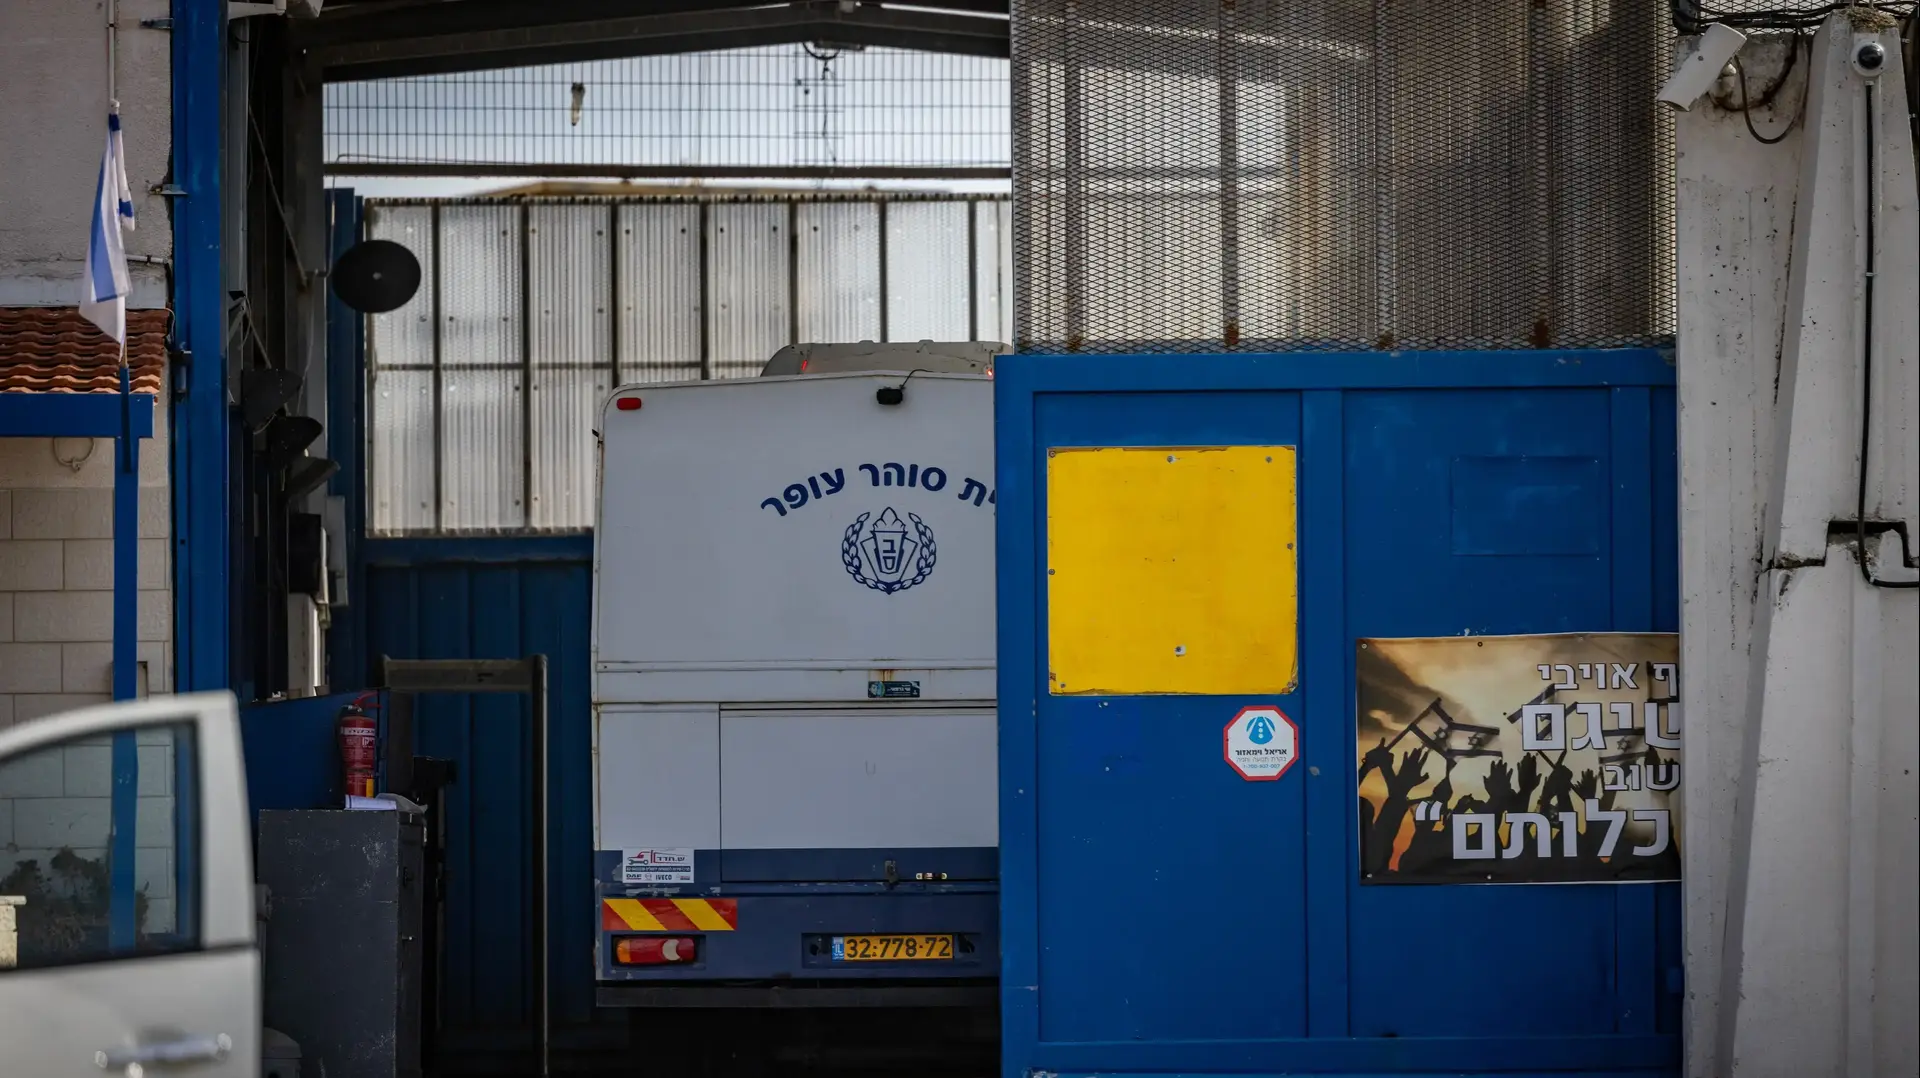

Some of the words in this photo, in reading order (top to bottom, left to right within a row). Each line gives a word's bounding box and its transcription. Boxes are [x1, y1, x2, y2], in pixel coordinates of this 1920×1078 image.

[858, 462, 947, 492] סוהר
[760, 467, 845, 517] עופר
[1536, 662, 1639, 690] אויבי
[1604, 763, 1681, 792] שוב
